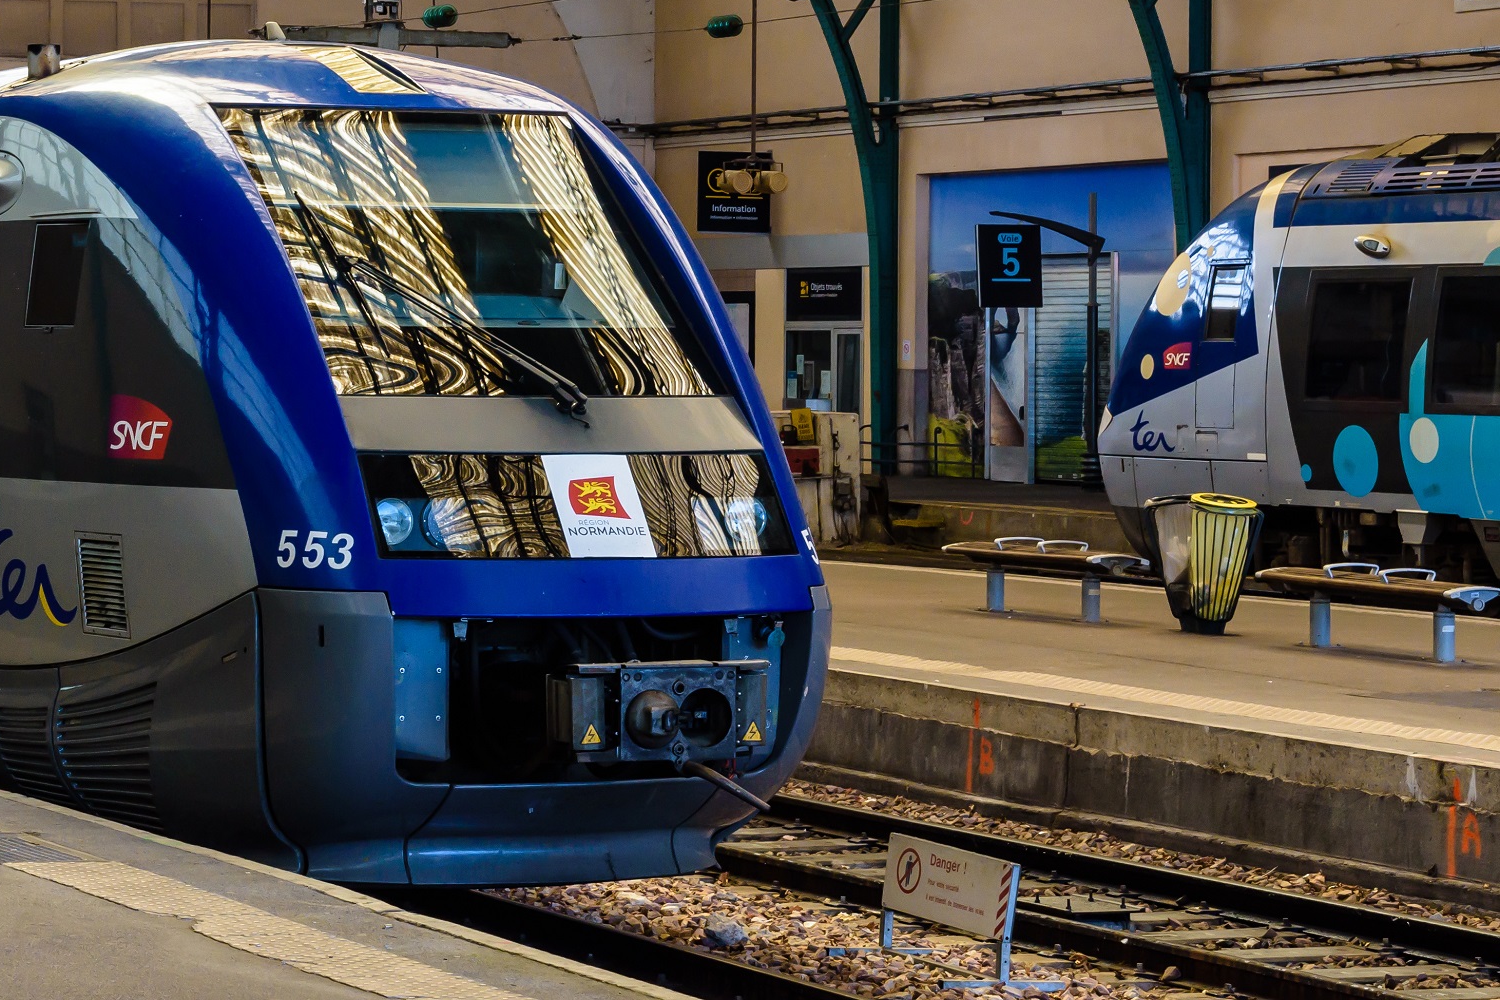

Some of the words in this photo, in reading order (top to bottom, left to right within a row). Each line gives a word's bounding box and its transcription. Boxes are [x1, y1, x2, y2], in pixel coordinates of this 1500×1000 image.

[711, 203, 757, 213] Information
[1000, 234, 1019, 243] Voie
[1002, 247, 1020, 277] 5
[1164, 352, 1191, 366] SNCF
[109, 420, 169, 451] SNCF
[1129, 409, 1176, 453] ter
[568, 526, 647, 537] NORMANDIE
[276, 529, 355, 570] 553
[979, 736, 995, 775] B
[1461, 811, 1482, 858] A
[930, 853, 960, 874] Danger
[963, 862, 967, 875] !
